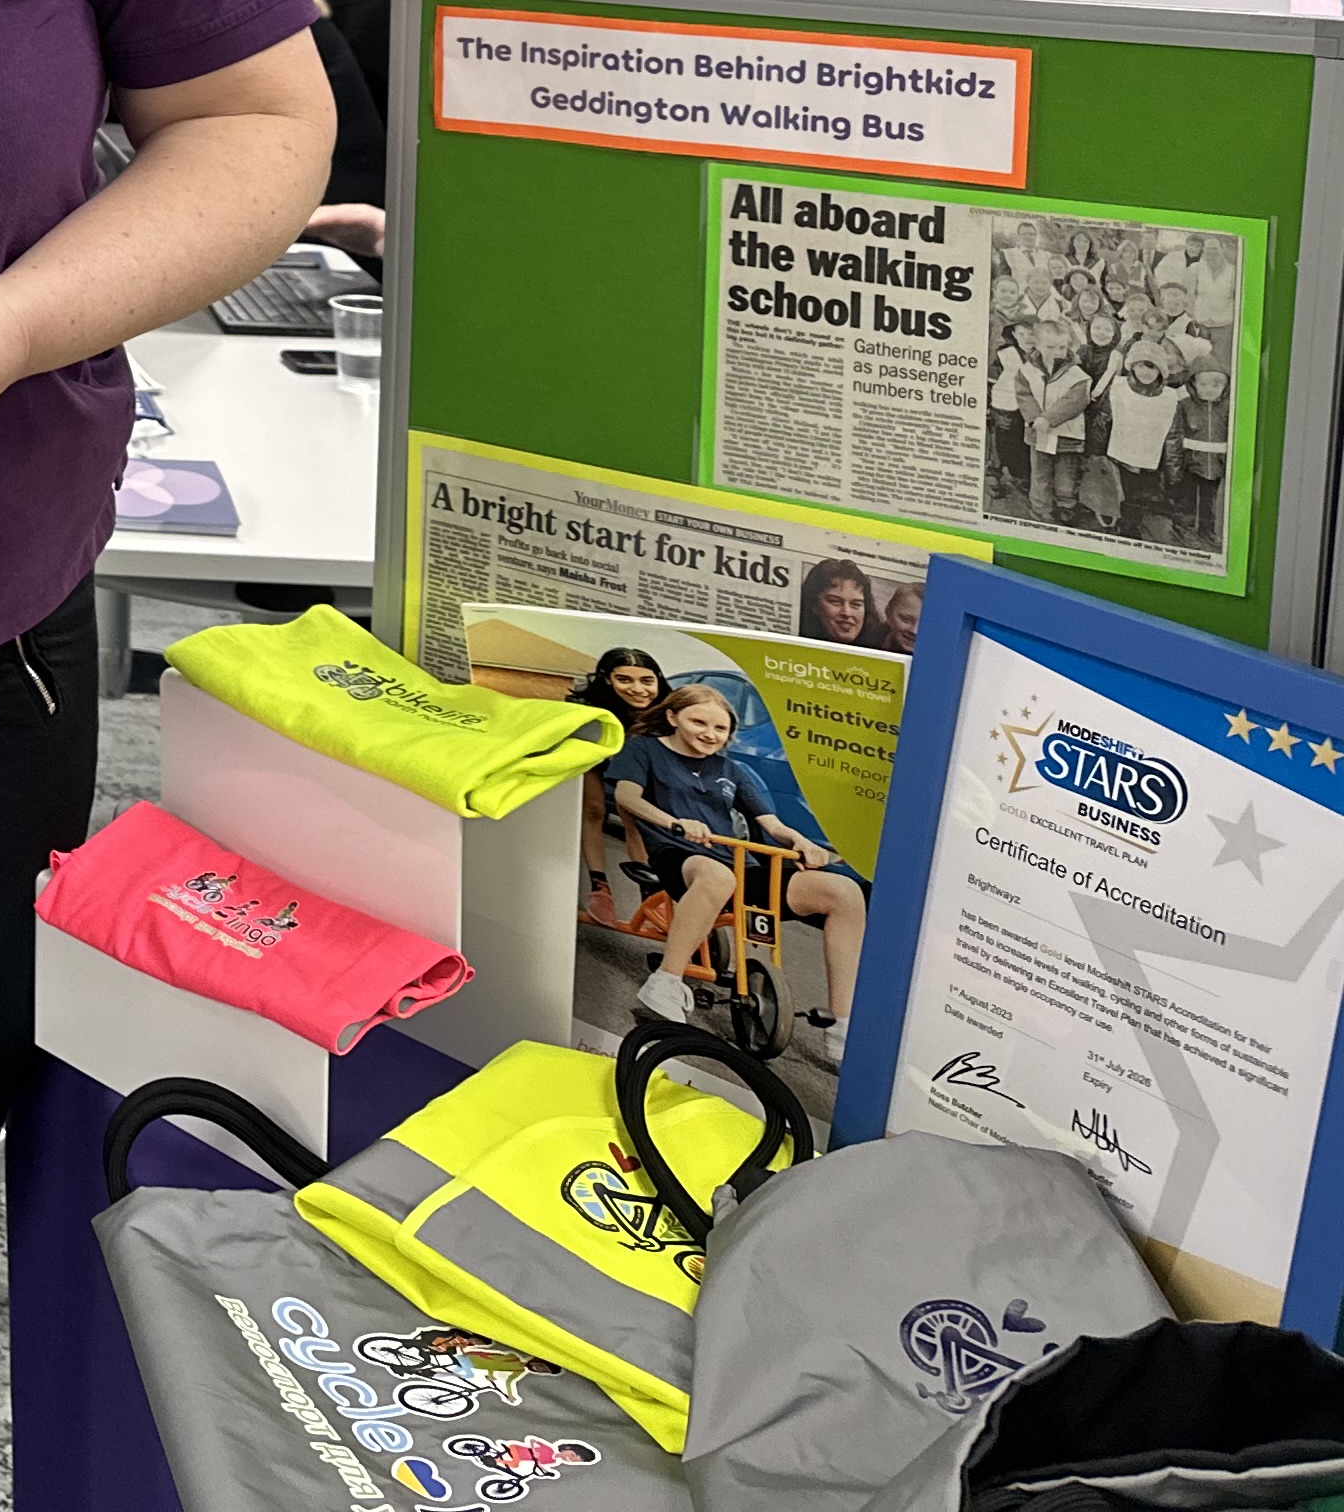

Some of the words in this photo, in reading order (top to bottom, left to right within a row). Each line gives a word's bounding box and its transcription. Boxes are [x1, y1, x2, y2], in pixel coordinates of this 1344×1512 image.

[456, 36, 512, 62] The
[520, 40, 685, 77] Inspiration
[694, 53, 807, 85] Behind
[816, 62, 996, 100] Brightkidz
[529, 86, 710, 124] Geddington
[721, 101, 851, 140] Walking
[862, 115, 925, 142] Bus
[730, 184, 783, 224] All
[794, 193, 945, 244] aboard
[729, 230, 794, 272] the
[807, 245, 974, 302] walking
[728, 281, 861, 329] school
[874, 294, 952, 341] bus
[853, 338, 932, 366] Gathering
[938, 351, 978, 370] pace
[853, 360, 873, 374] as
[879, 363, 965, 388] passenger
[853, 379, 924, 402] numbers
[930, 387, 978, 409] treble
[431, 482, 453, 512] A
[461, 487, 557, 536] bright
[565, 517, 647, 558] start
[655, 533, 705, 570] for
[714, 545, 789, 588] kids
[498, 535, 530, 550] Profits
[531, 543, 543, 555] go
[545, 545, 568, 561] back
[570, 553, 589, 565] into
[591, 558, 620, 574] social
[537, 563, 557, 577] says
[764, 656, 896, 695] brightwayz
[764, 671, 814, 689] inspiring
[817, 682, 854, 697] active
[857, 688, 891, 703] travel
[786, 698, 900, 737] Initiatives
[786, 725, 801, 739] &
[807, 730, 896, 764] Impacts
[808, 753, 835, 770] Full
[1043, 738, 1165, 816] STARS
[1030, 814, 1084, 843] EXCELLENT
[1085, 834, 1120, 858] TRAVEL
[1121, 850, 1148, 869] PLAN
[1077, 803, 1161, 846] BUSINESS
[967, 873, 1021, 905] Brightwayz
[975, 827, 1067, 879] Certificate
[1073, 870, 1093, 888] of
[1095, 877, 1226, 946] Accreditation
[754, 914, 769, 935] 6
[1040, 943, 1063, 960] Gold
[214, 1293, 342, 1445] велоспорт
[271, 1296, 414, 1454] cycle
